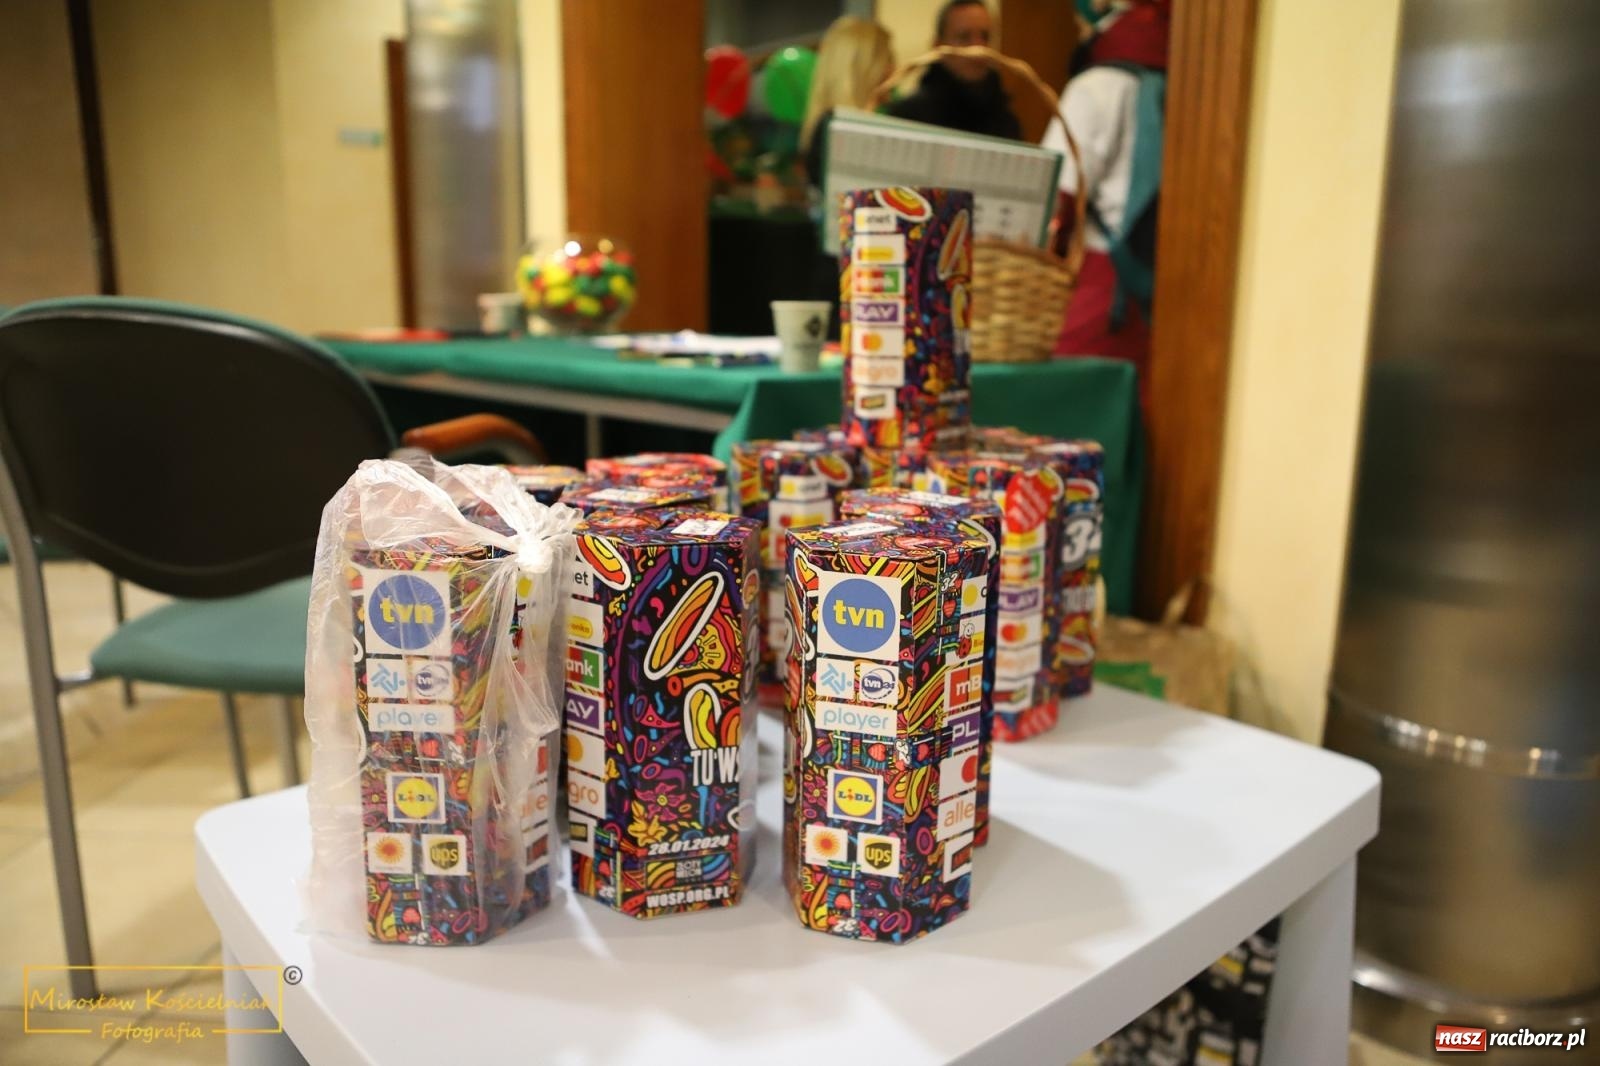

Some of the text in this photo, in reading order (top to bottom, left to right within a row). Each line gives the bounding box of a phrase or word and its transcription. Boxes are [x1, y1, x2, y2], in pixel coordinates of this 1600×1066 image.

[379, 597, 435, 625] tvn
[833, 599, 885, 629] tvn
[823, 708, 889, 730] player
[944, 801, 975, 828] alle
[430, 846, 464, 869] ups
[866, 846, 891, 866] ups
